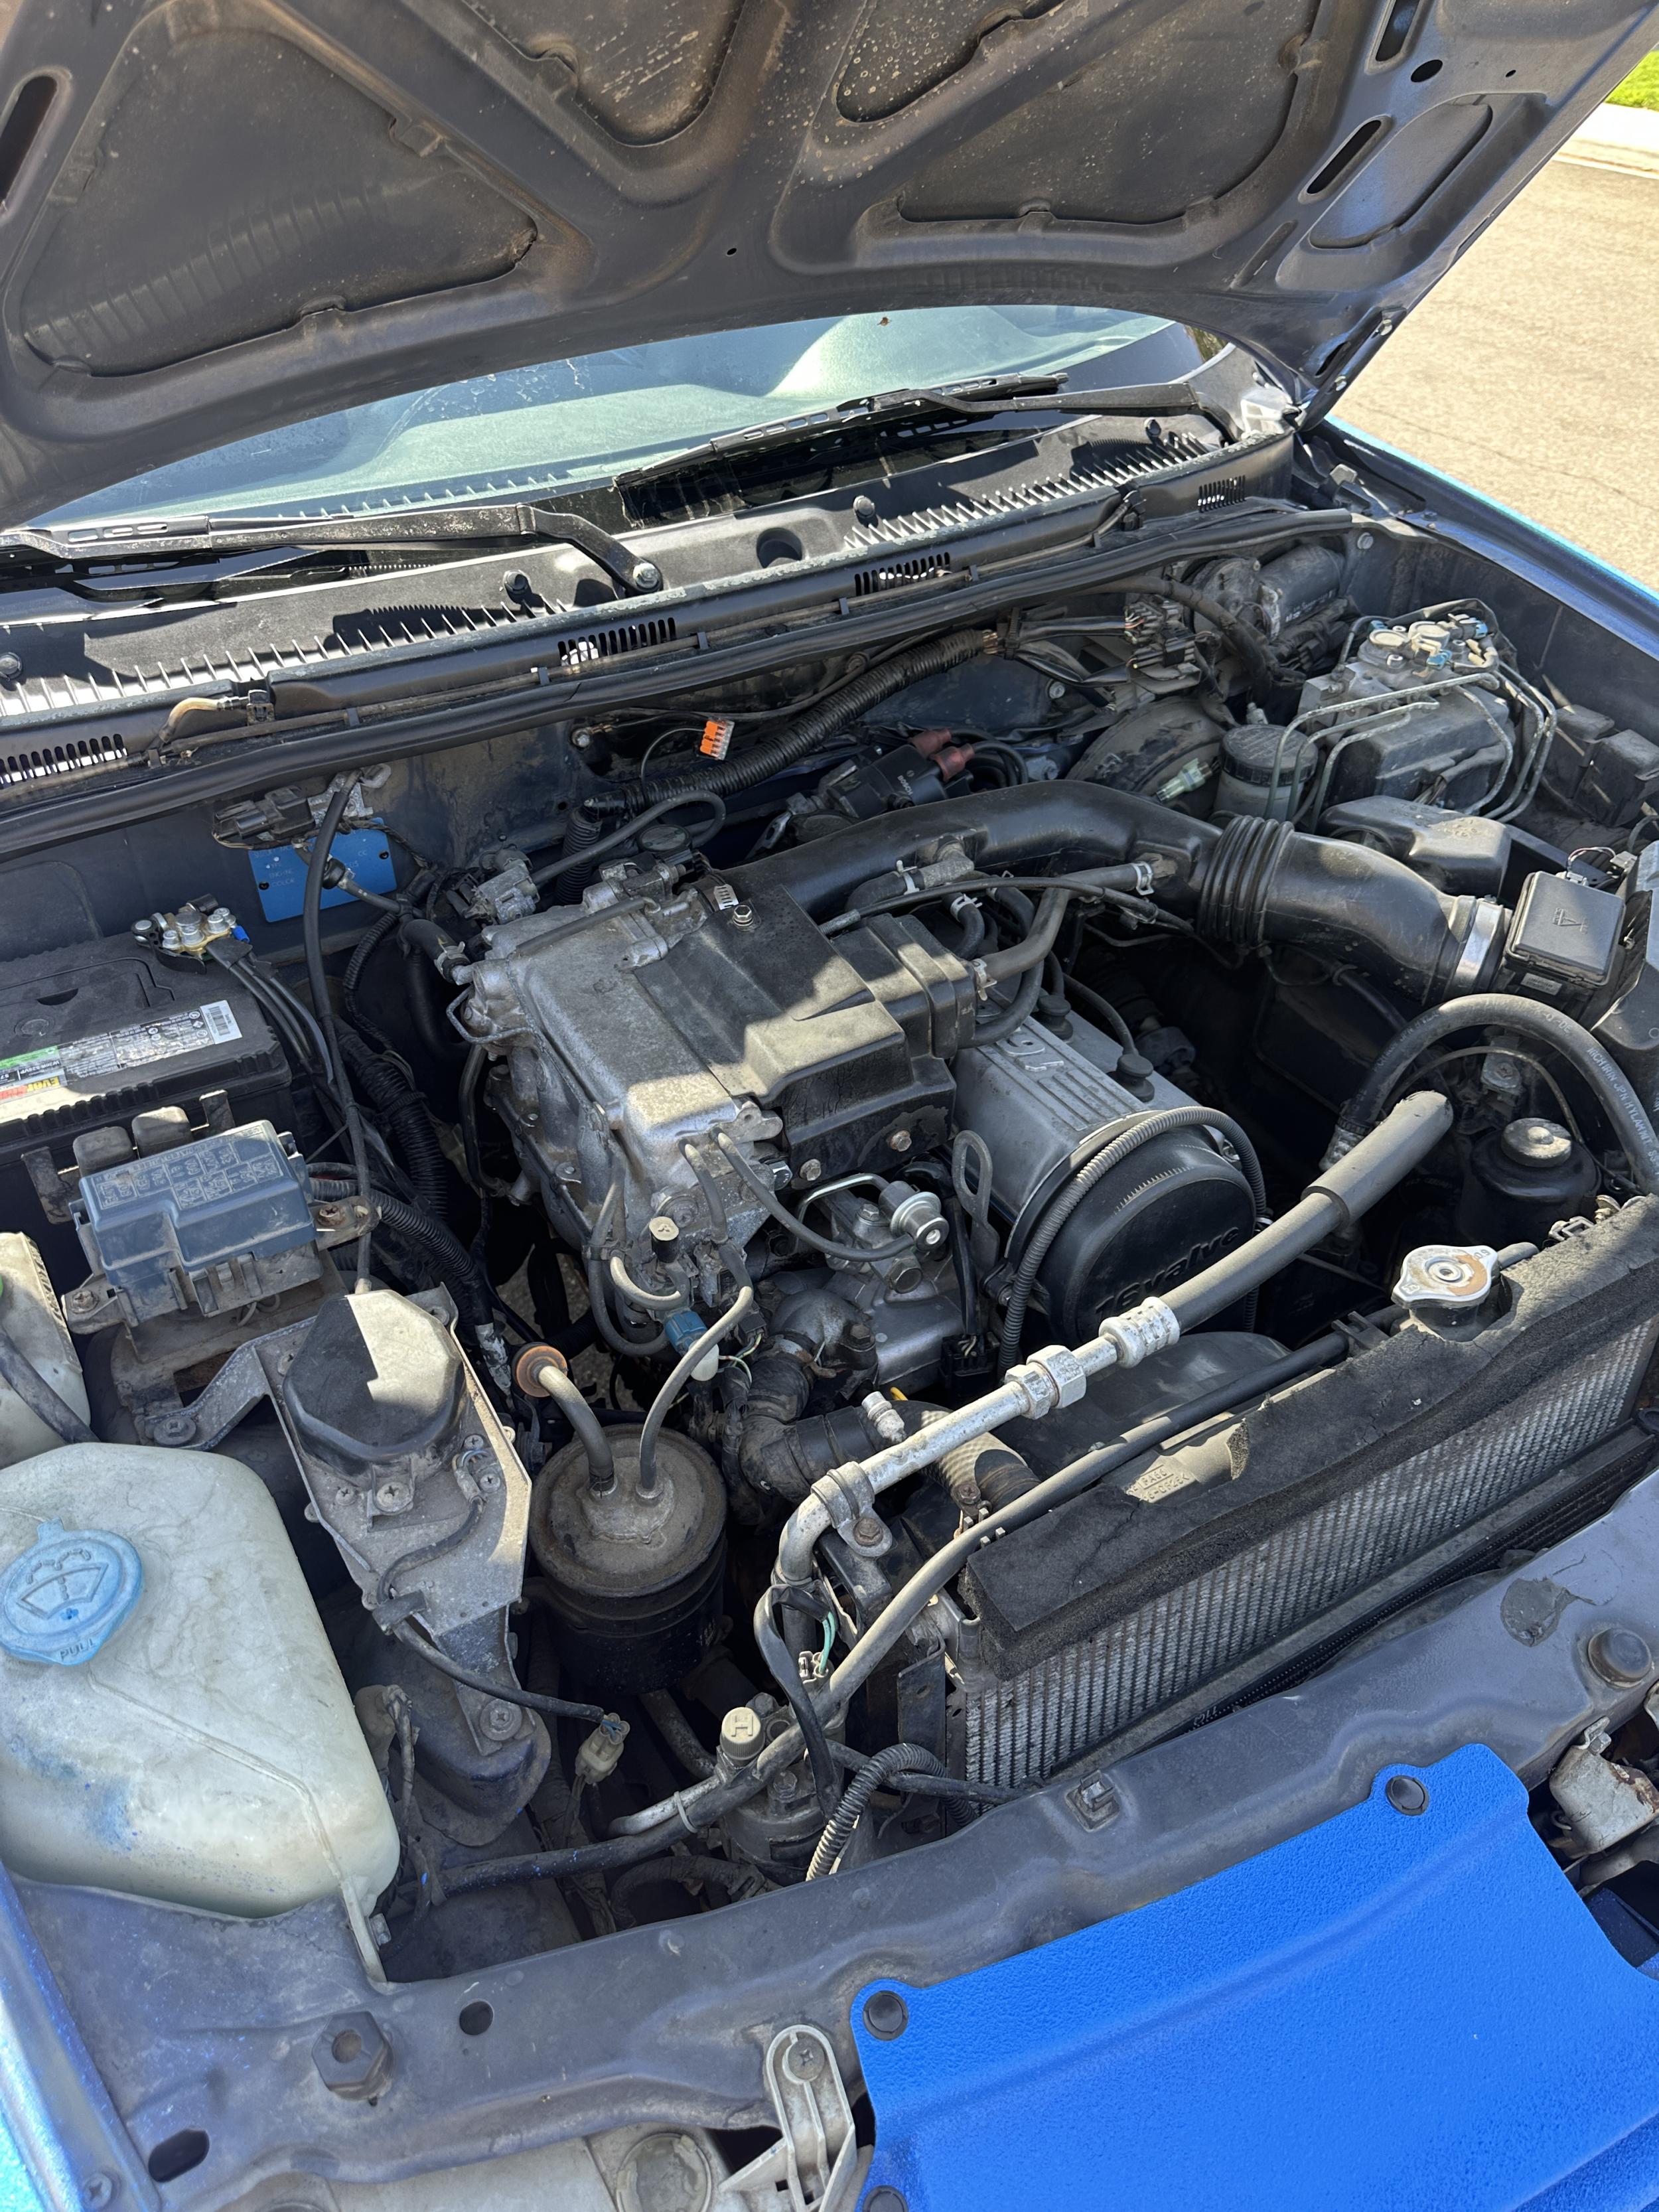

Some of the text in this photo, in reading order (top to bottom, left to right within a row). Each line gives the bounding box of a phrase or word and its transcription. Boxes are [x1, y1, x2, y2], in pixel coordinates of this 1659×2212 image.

[897, 774, 914, 796] BOSCH
[60, 1638, 94, 1661] PULL
[731, 1713, 753, 1737] H
